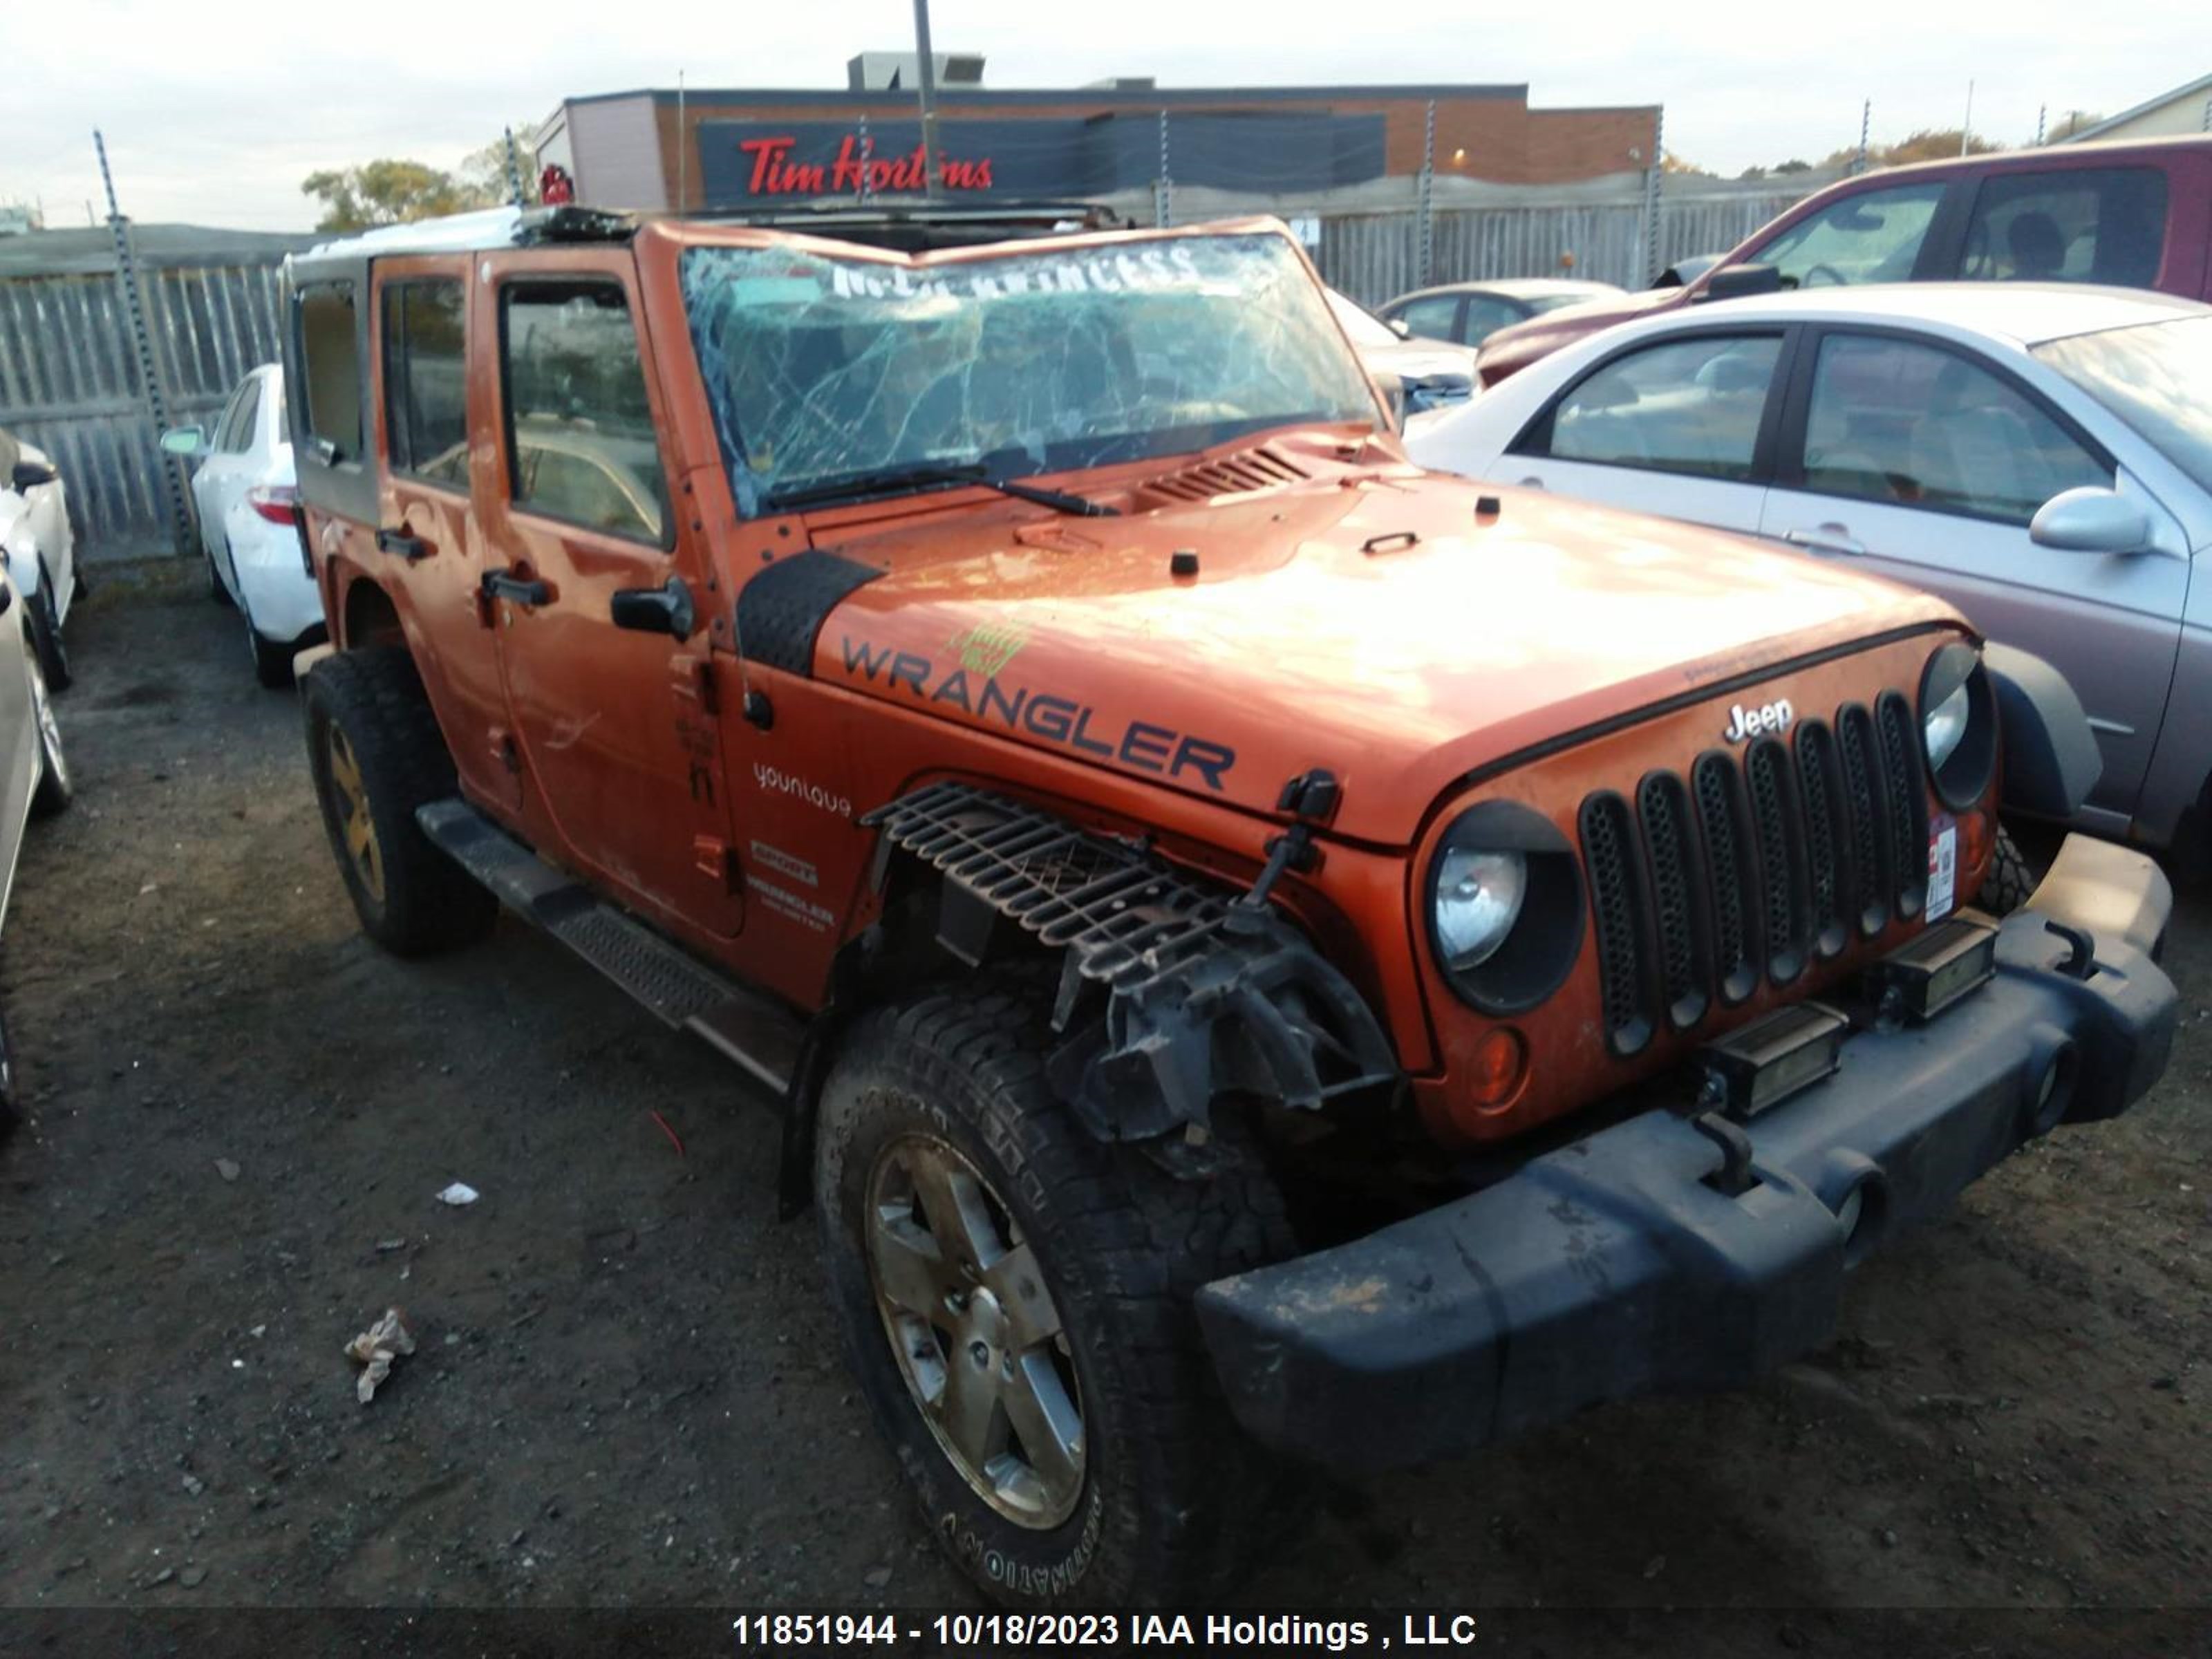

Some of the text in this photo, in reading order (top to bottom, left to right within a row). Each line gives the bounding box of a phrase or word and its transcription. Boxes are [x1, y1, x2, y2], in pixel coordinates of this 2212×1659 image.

[740, 134, 991, 194] Tim Hortns
[842, 634, 1237, 791] WRANGLER
[1725, 698, 1793, 742] Jeep
